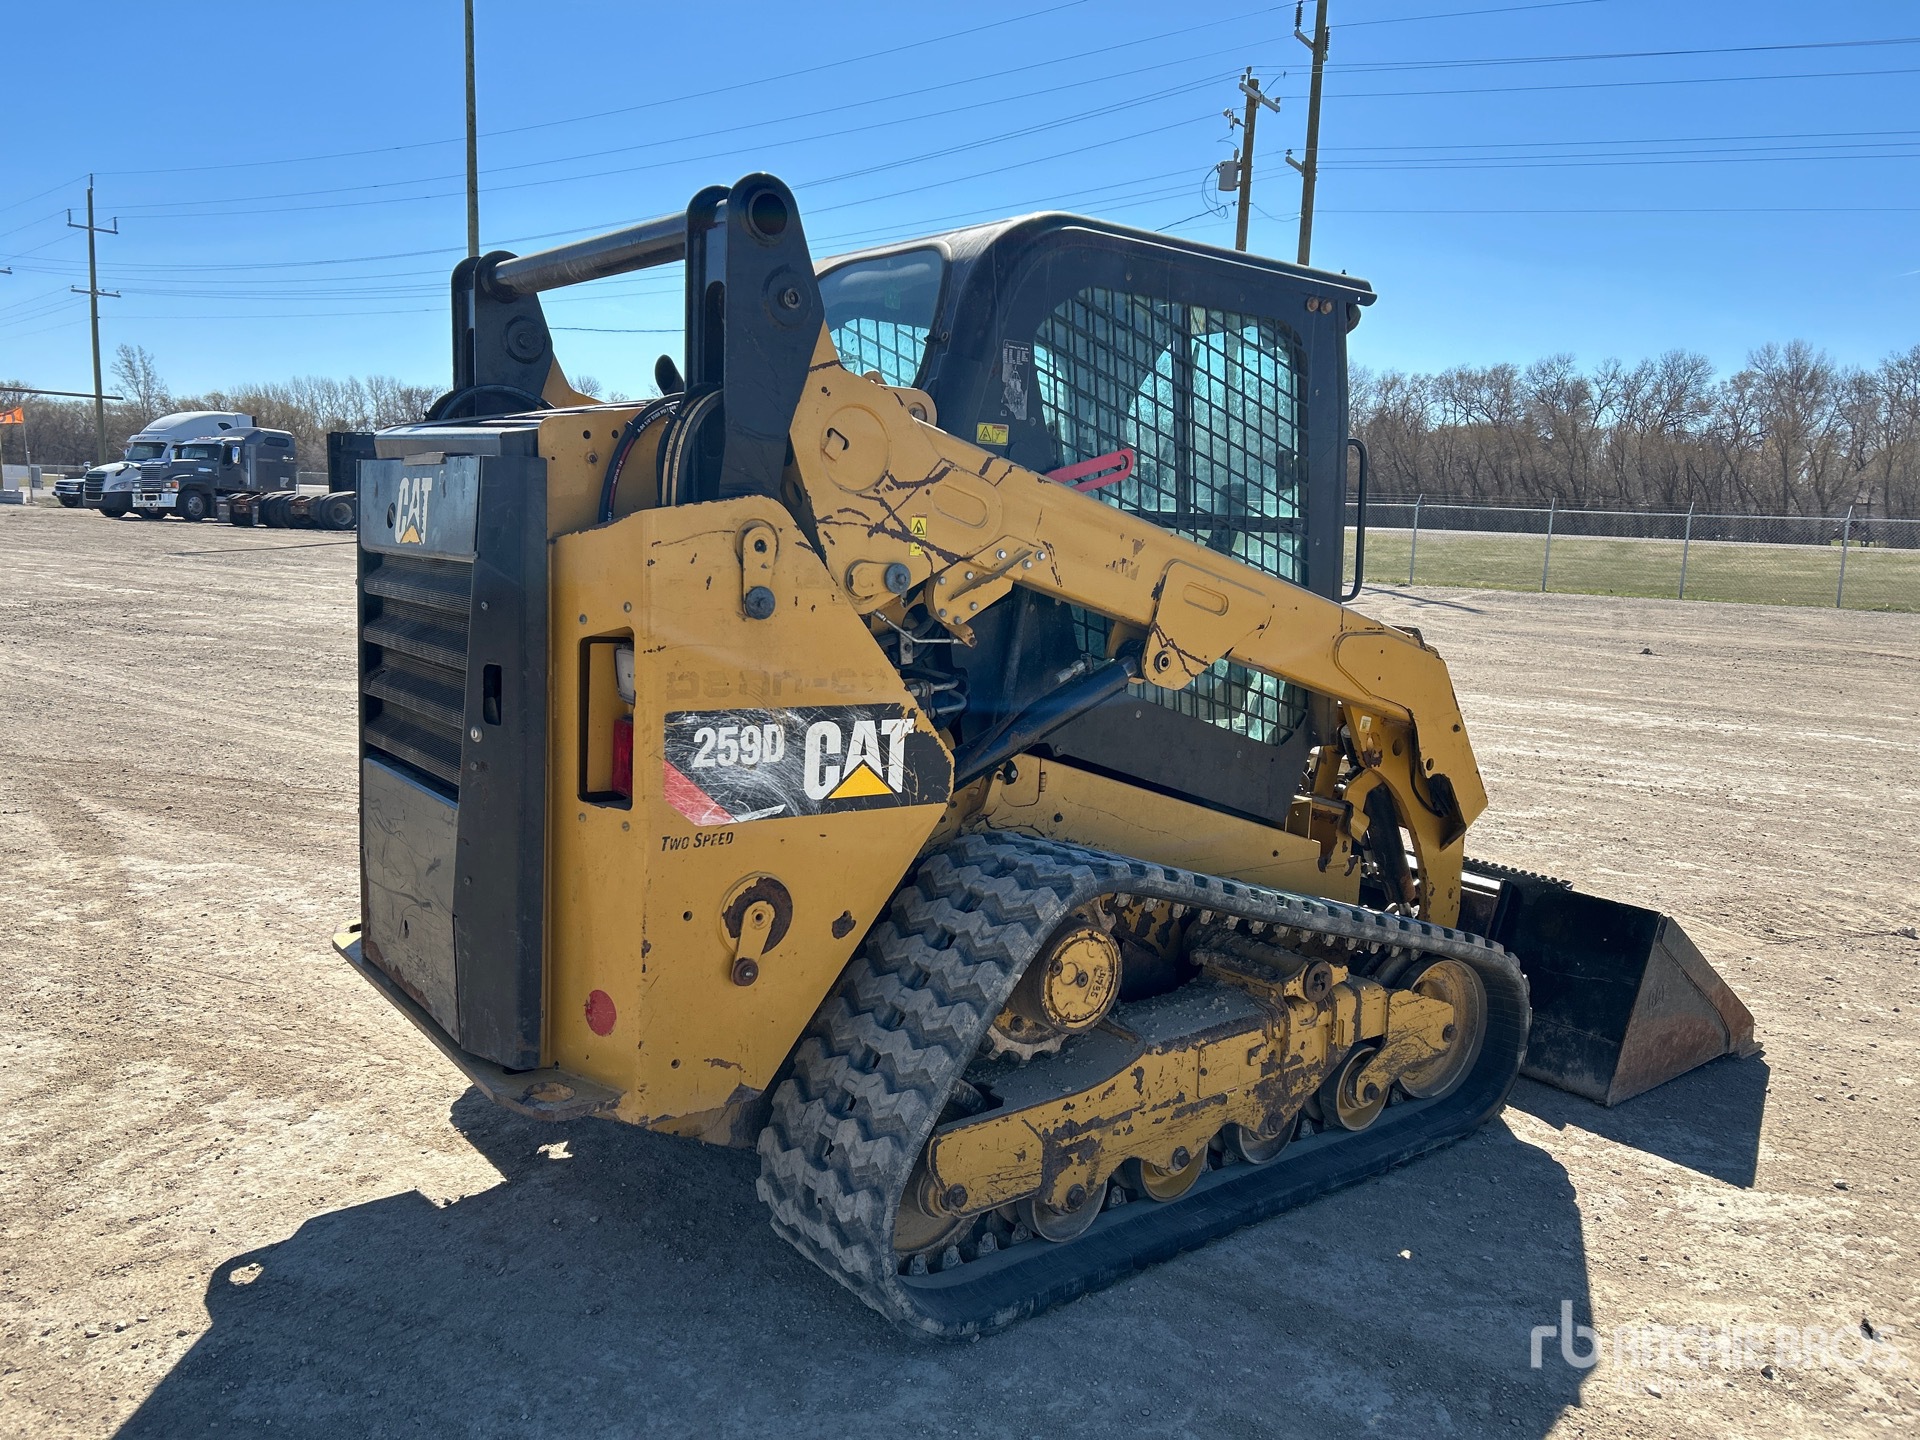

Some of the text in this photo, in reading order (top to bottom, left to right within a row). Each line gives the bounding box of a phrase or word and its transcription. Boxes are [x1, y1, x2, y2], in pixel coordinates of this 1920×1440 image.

[395, 477, 433, 545] CAT
[692, 718, 915, 801] 259D CAT
